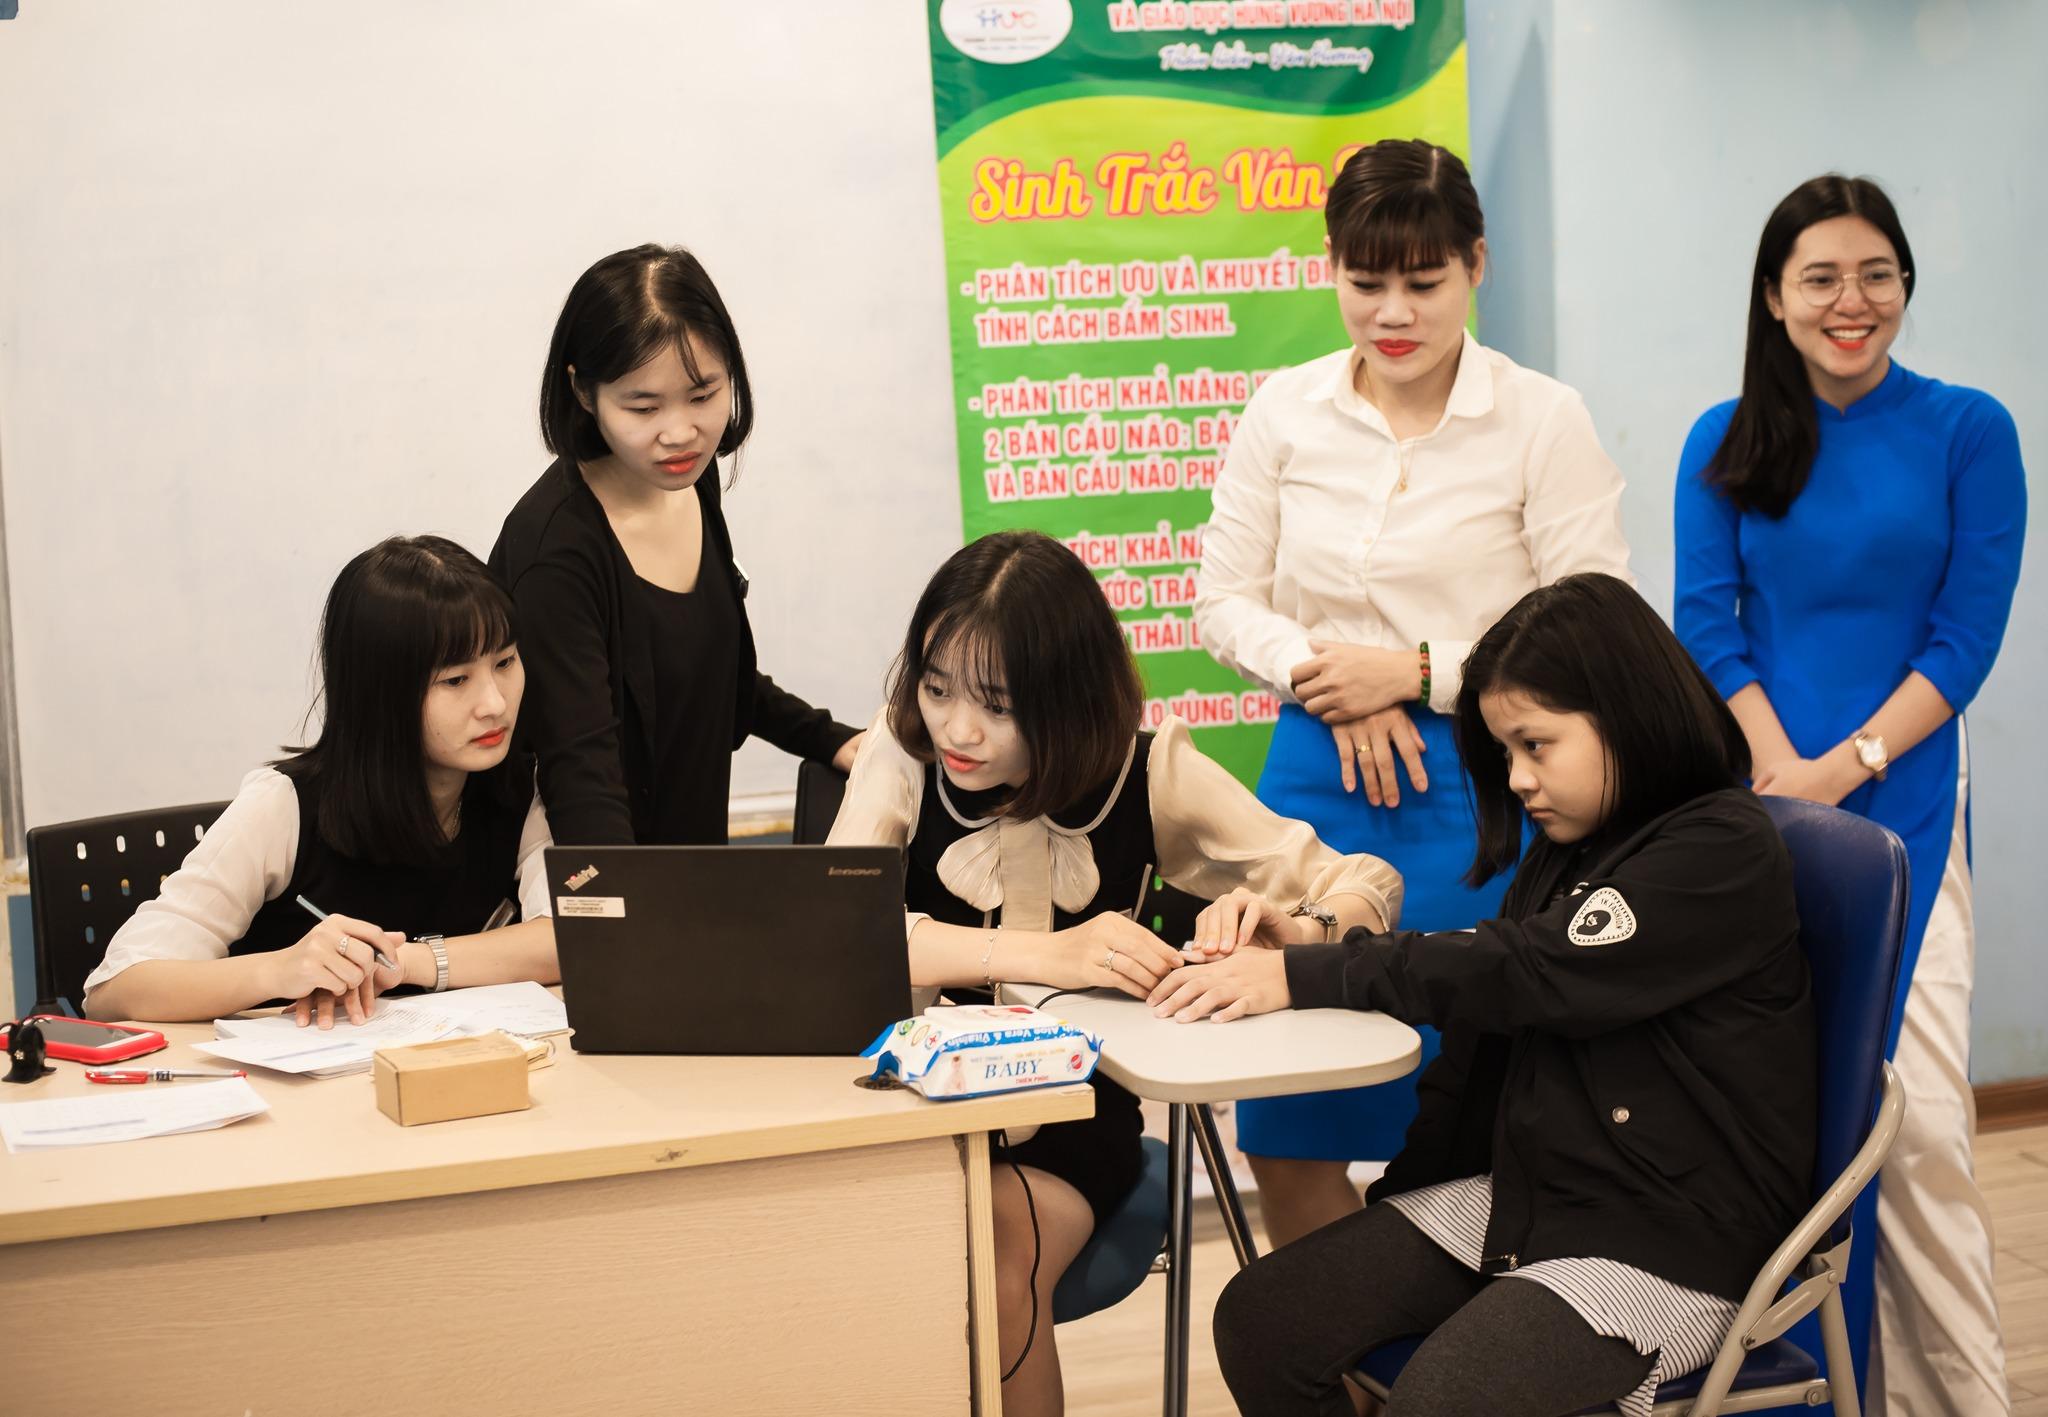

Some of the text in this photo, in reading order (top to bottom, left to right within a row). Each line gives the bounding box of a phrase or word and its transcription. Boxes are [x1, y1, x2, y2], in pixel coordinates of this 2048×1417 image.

[972, 159, 1090, 221] Sinh
[1098, 143, 1219, 215] Trắc
[1226, 148, 1326, 209] Vân
[978, 264, 1047, 300] PHÂN
[1055, 262, 1113, 296] TÍCH
[1122, 263, 1158, 293] ƯU
[1163, 257, 1197, 293] VÀ
[1204, 250, 1298, 290] KHUYẾT
[977, 309, 1029, 345] TÍNH
[1035, 307, 1099, 341] CÁCH
[1168, 306, 1233, 334] SINH.
[984, 379, 1049, 415] PHÂN
[1055, 376, 1113, 412] TÍCH
[1118, 366, 1173, 407] KHẢ
[1177, 370, 1247, 404] NĂNG
[986, 430, 1001, 459] 2
[1006, 422, 1058, 457] BÁN
[1126, 416, 1191, 449] NÃO:
[1199, 412, 1238, 447] BÁ
[987, 464, 1017, 499] VÀ
[1021, 463, 1068, 496] BÁN
[1128, 457, 1179, 489] NÃO
[1124, 523, 1173, 563] KHẢ
[1179, 526, 1203, 560] N
[1131, 615, 1185, 651] THÁI
[1170, 691, 1235, 725] VÙNG
[829, 866, 882, 876] lenovo
[1004, 1028, 1032, 1039] Vera
[984, 1059, 1042, 1079] BABY
